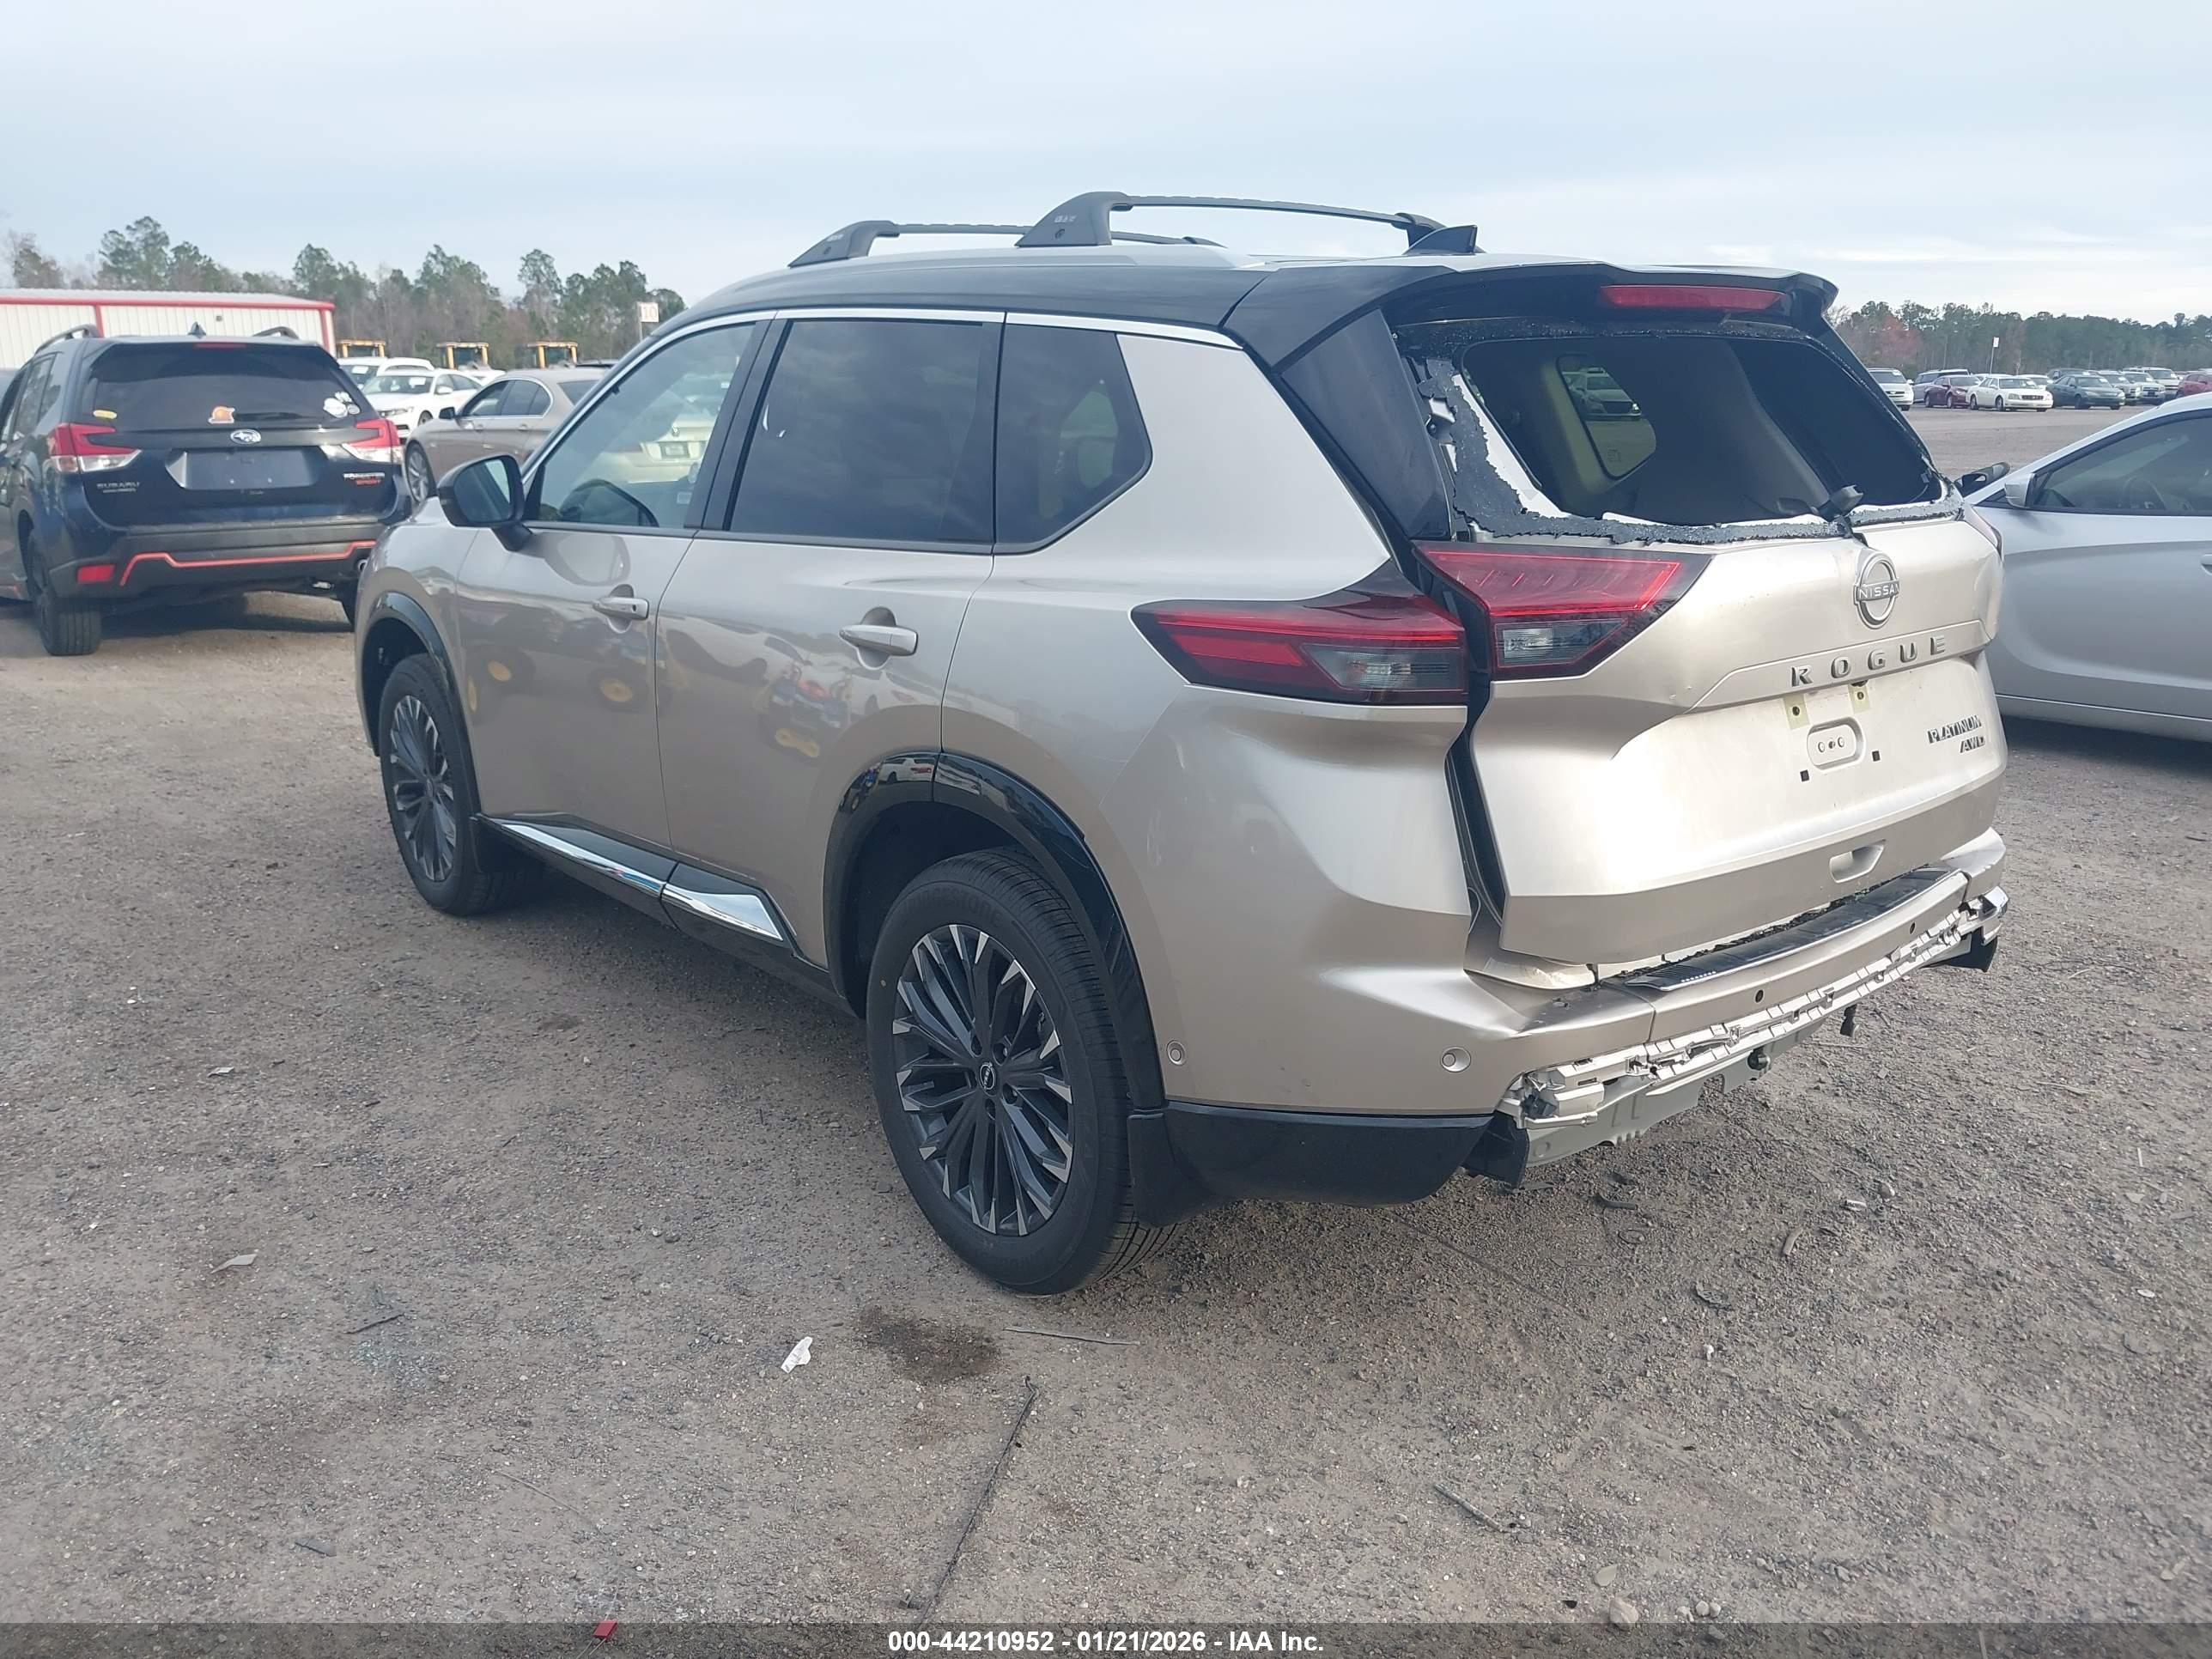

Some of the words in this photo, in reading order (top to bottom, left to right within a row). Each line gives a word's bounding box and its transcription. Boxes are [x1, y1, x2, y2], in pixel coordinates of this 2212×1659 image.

[1858, 581, 1899, 599] NISSAN
[1791, 635, 1946, 687] ROGUE
[1927, 714, 1982, 744] PLATINUM
[1960, 736, 1985, 753] AWD
